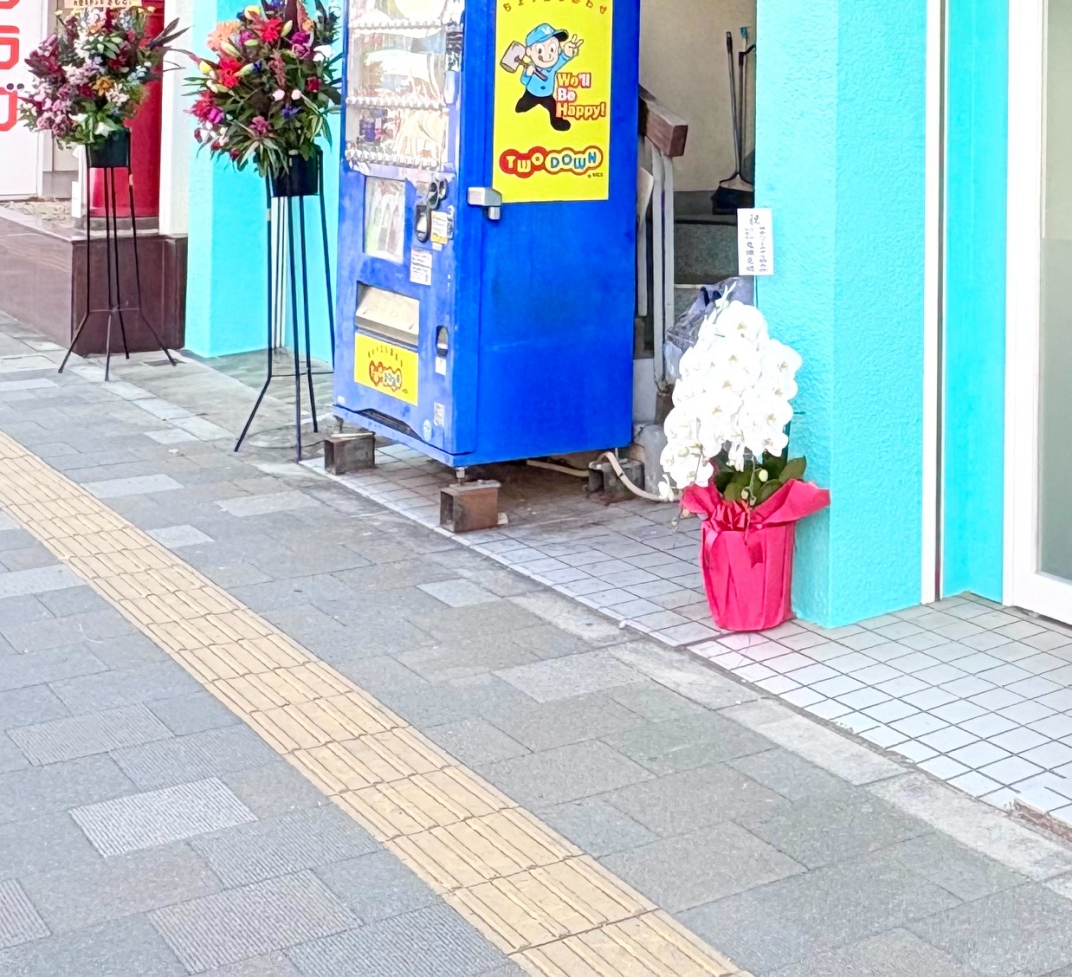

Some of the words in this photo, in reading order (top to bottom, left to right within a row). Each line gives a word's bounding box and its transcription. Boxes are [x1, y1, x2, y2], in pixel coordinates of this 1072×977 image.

[556, 102, 606, 120] Happy!
[505, 152, 545, 173] TWO
[550, 151, 598, 170] DOWN
